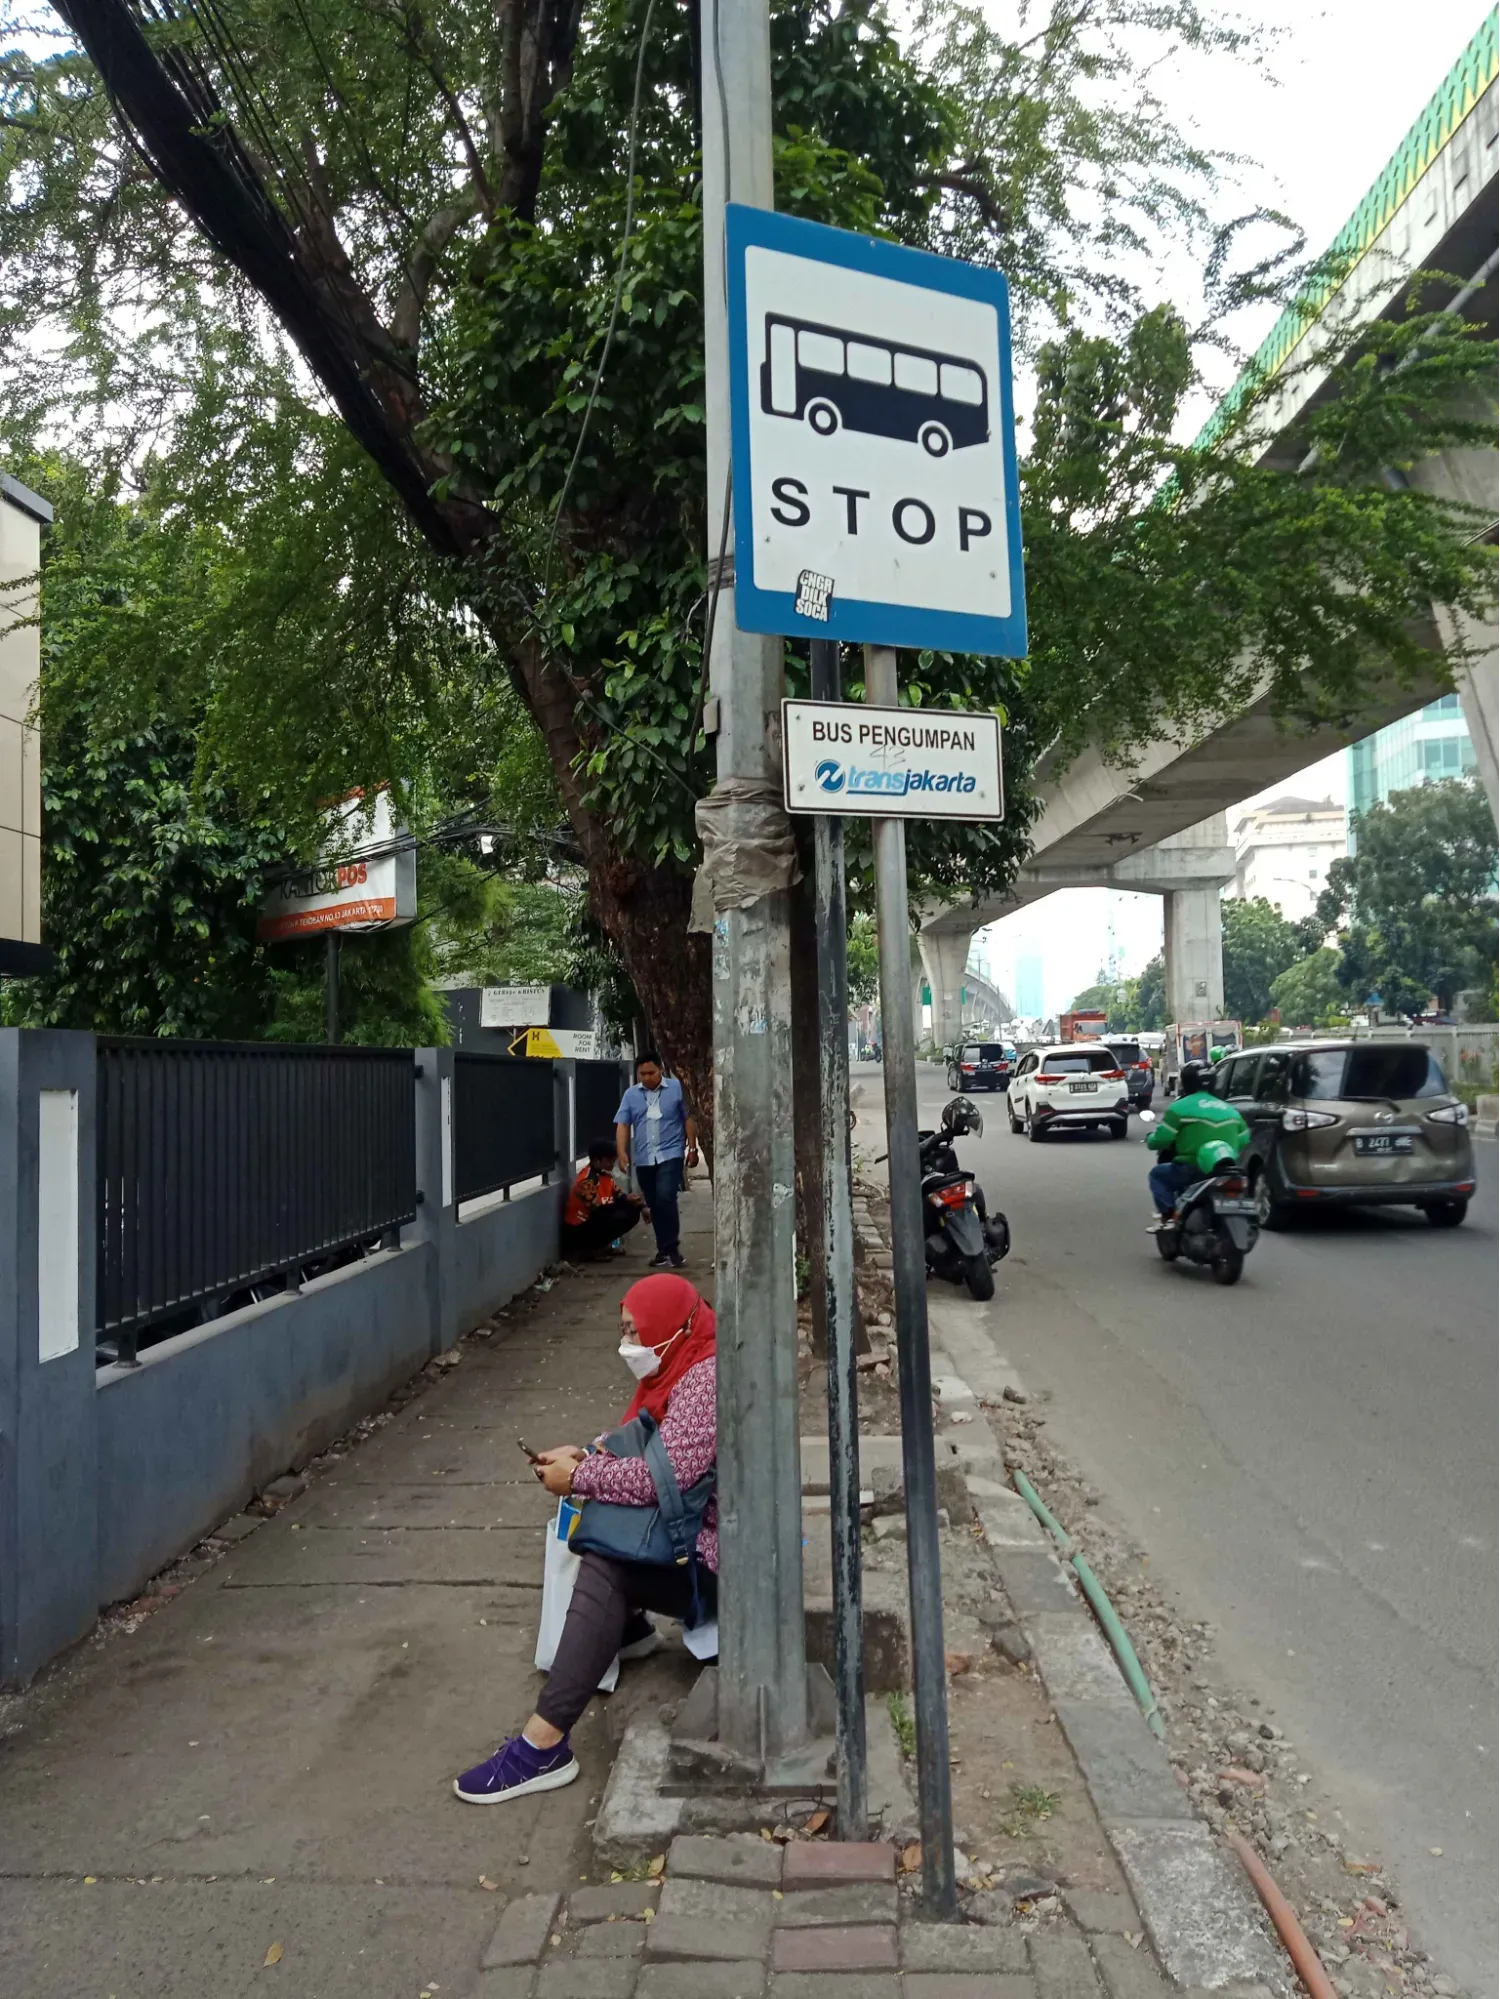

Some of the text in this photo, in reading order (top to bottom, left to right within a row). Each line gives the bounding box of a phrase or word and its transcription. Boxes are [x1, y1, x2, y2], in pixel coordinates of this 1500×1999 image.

[770, 476, 992, 552] STOP
[795, 598, 828, 622] SOCA
[812, 721, 975, 751] BUS PENGUMPAN
[848, 765, 976, 796] transjakarta
[336, 863, 368, 888] POS
[341, 907, 367, 919] JAKARTA
